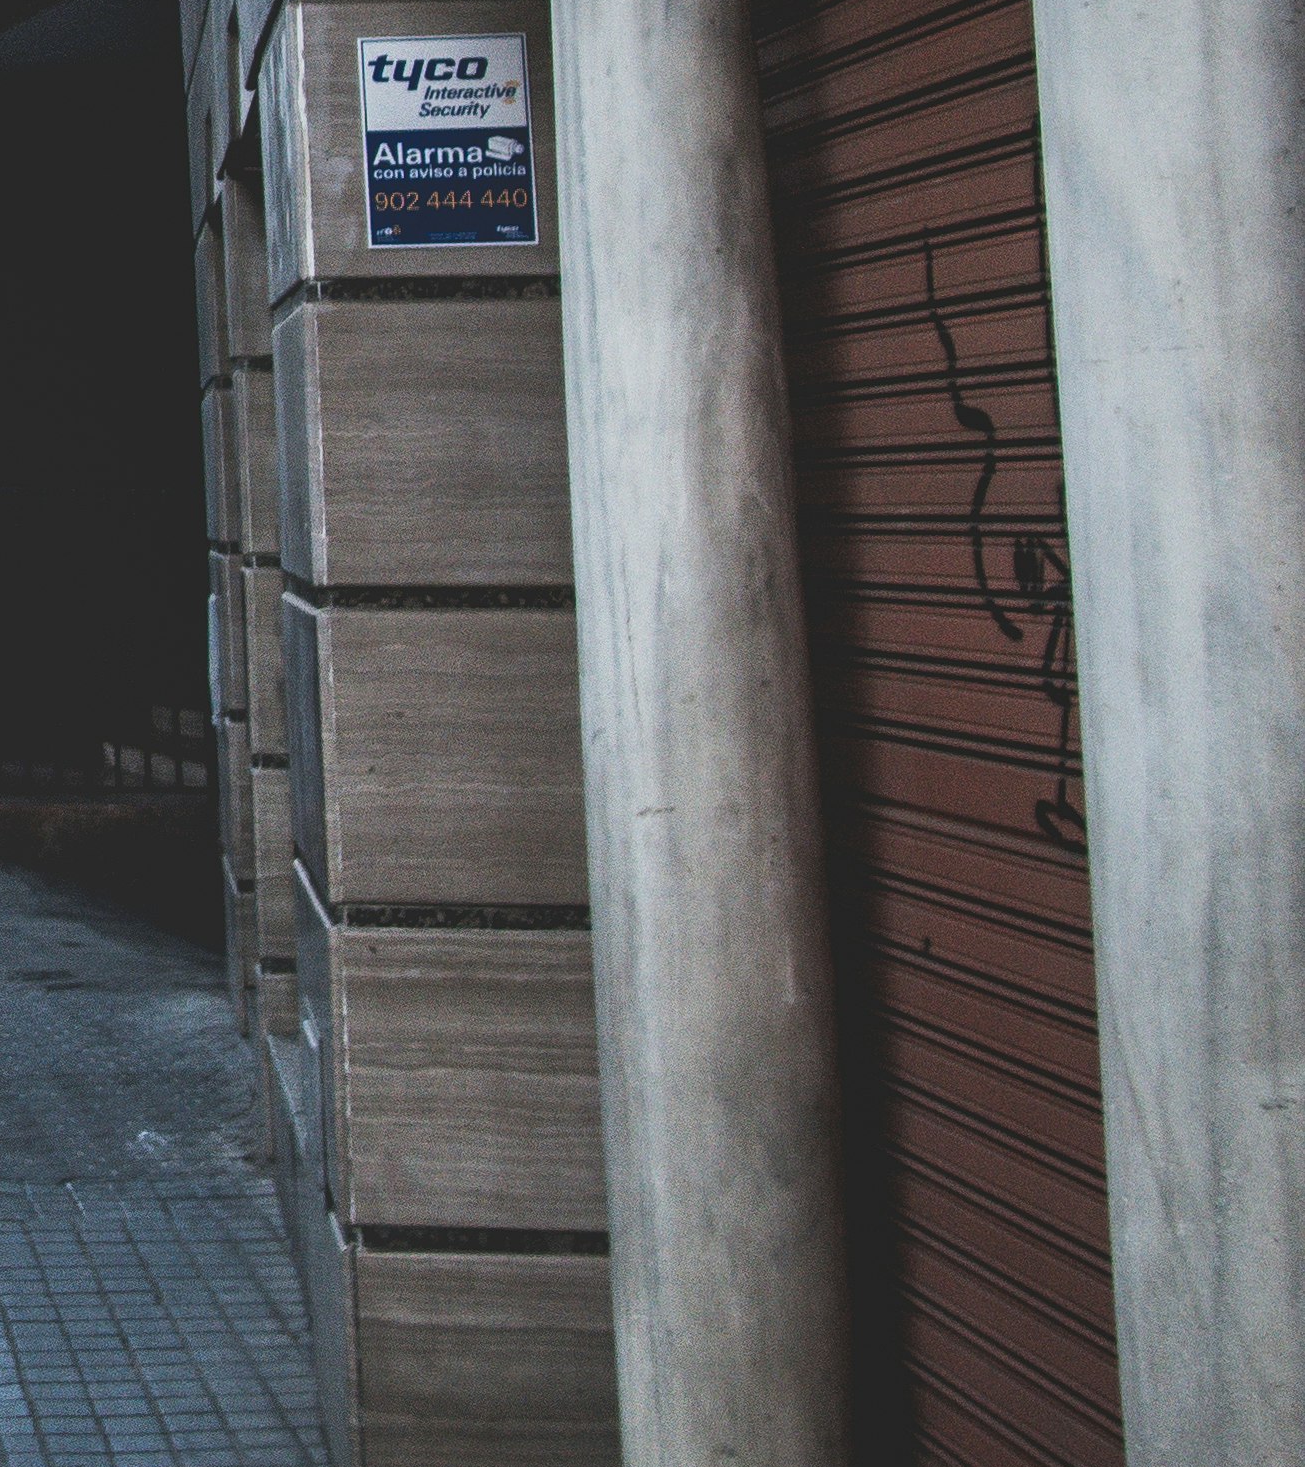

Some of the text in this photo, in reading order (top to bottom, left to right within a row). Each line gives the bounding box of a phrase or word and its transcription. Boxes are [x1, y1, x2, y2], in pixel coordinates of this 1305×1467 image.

[367, 54, 489, 91] tyco
[423, 82, 517, 101] Interactive
[418, 101, 492, 119] Security
[373, 141, 483, 166] Alarma
[373, 162, 527, 180] con aviso a policía
[374, 187, 529, 212] 902 444 440
